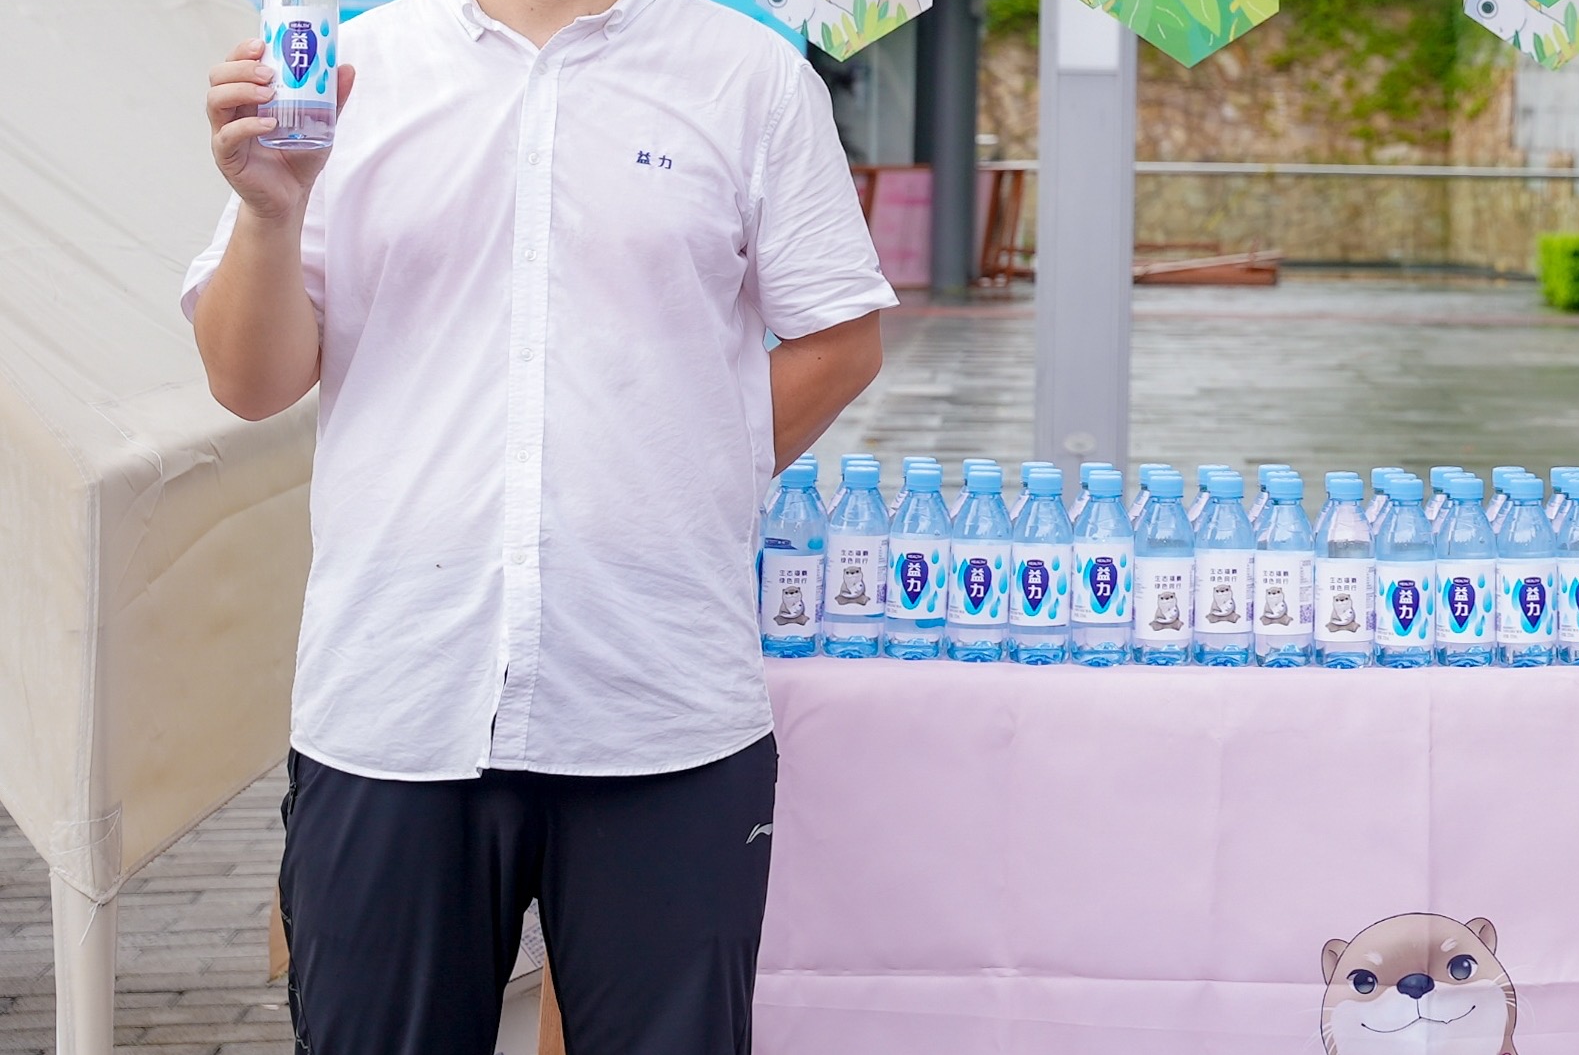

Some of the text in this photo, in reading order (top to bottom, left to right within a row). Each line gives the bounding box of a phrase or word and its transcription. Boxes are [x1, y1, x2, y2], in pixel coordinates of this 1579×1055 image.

[290, 32, 309, 67] 益力
[636, 150, 672, 170] 益力
[906, 562, 922, 592] 益力
[970, 568, 985, 598] 益力
[1027, 569, 1042, 599] 益力
[1096, 566, 1111, 596] 益力
[1399, 590, 1414, 620] 益力
[1454, 586, 1469, 616] 益力
[1526, 587, 1541, 617] 益力
